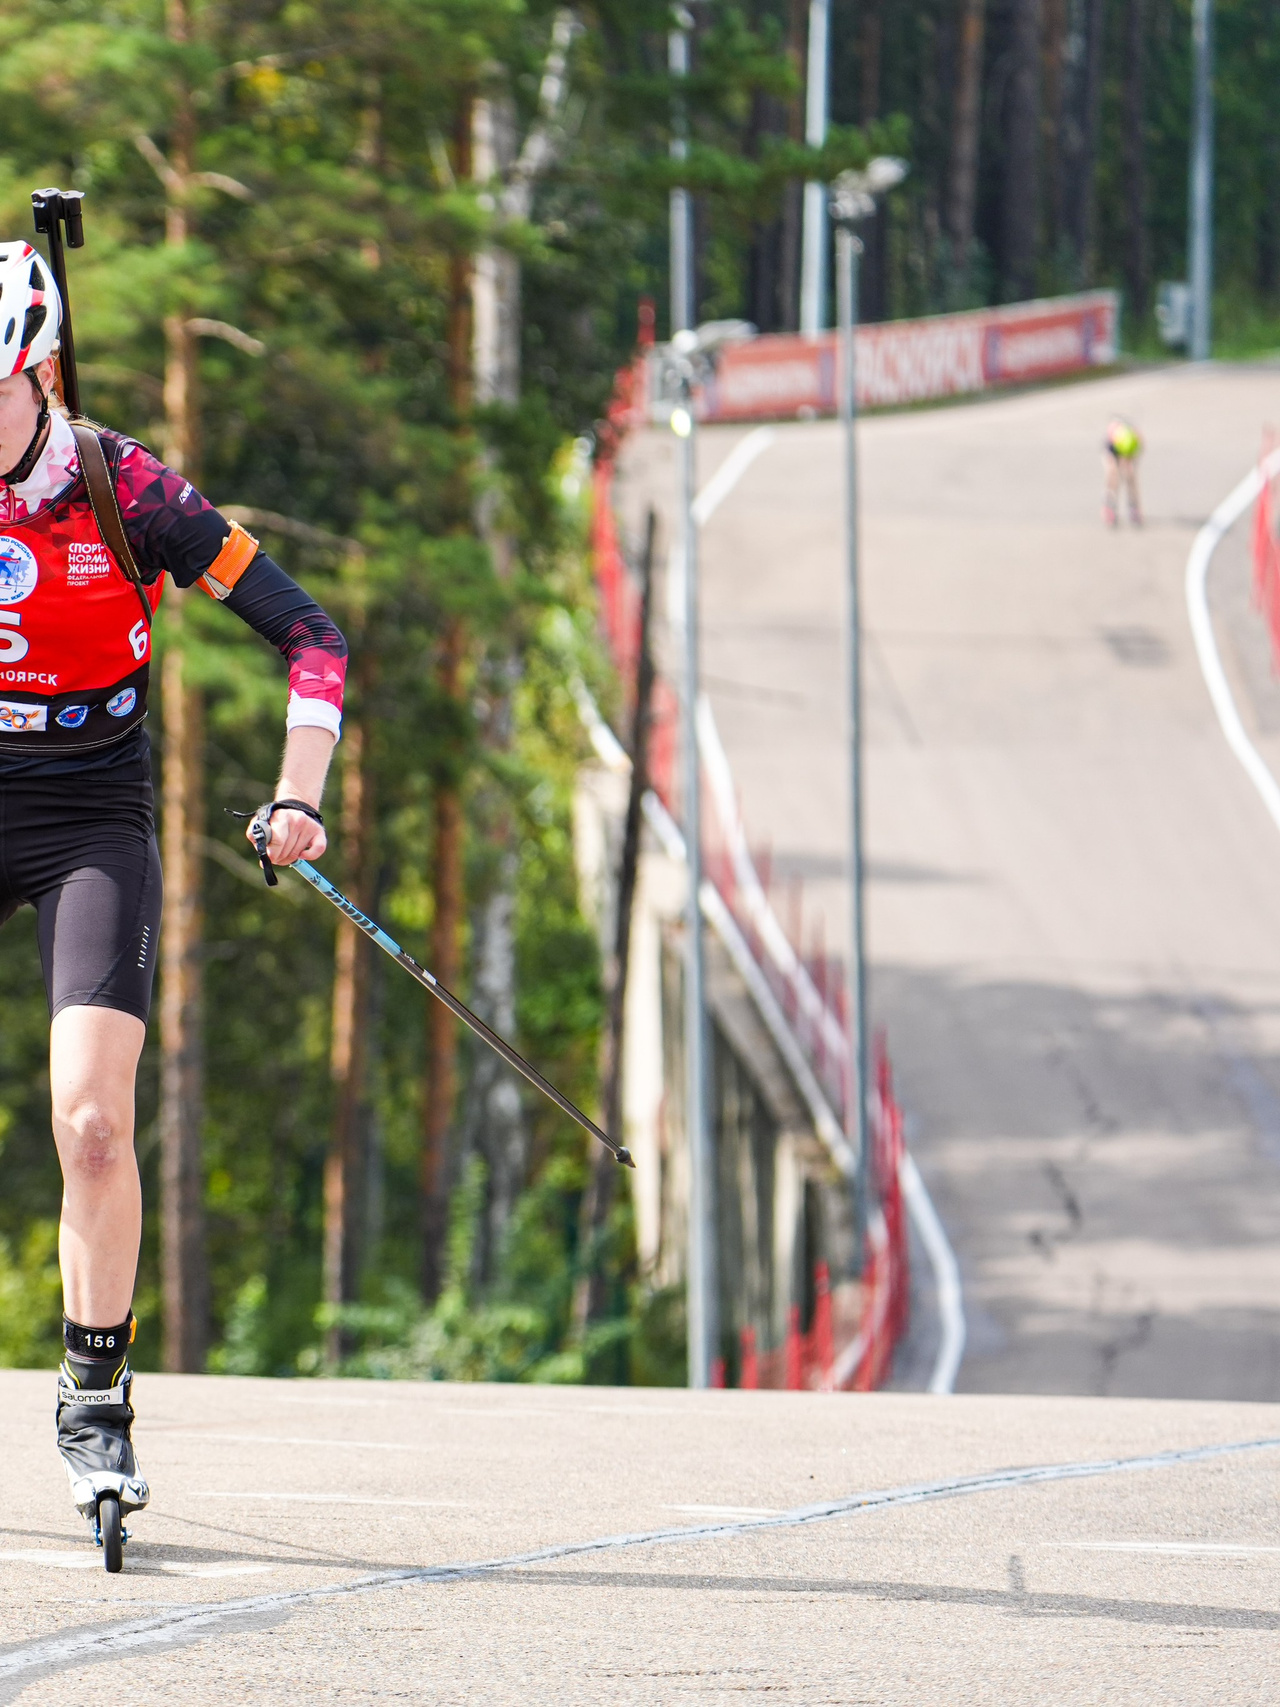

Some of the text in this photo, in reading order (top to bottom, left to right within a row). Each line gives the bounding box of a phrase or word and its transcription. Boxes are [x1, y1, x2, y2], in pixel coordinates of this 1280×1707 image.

[68, 543, 105, 554] СПОРТ-
[68, 553, 108, 563] НОРМА
[67, 563, 110, 574] ЖИЗНИ
[128, 618, 148, 661] 6
[84, 1333, 115, 1348] 156
